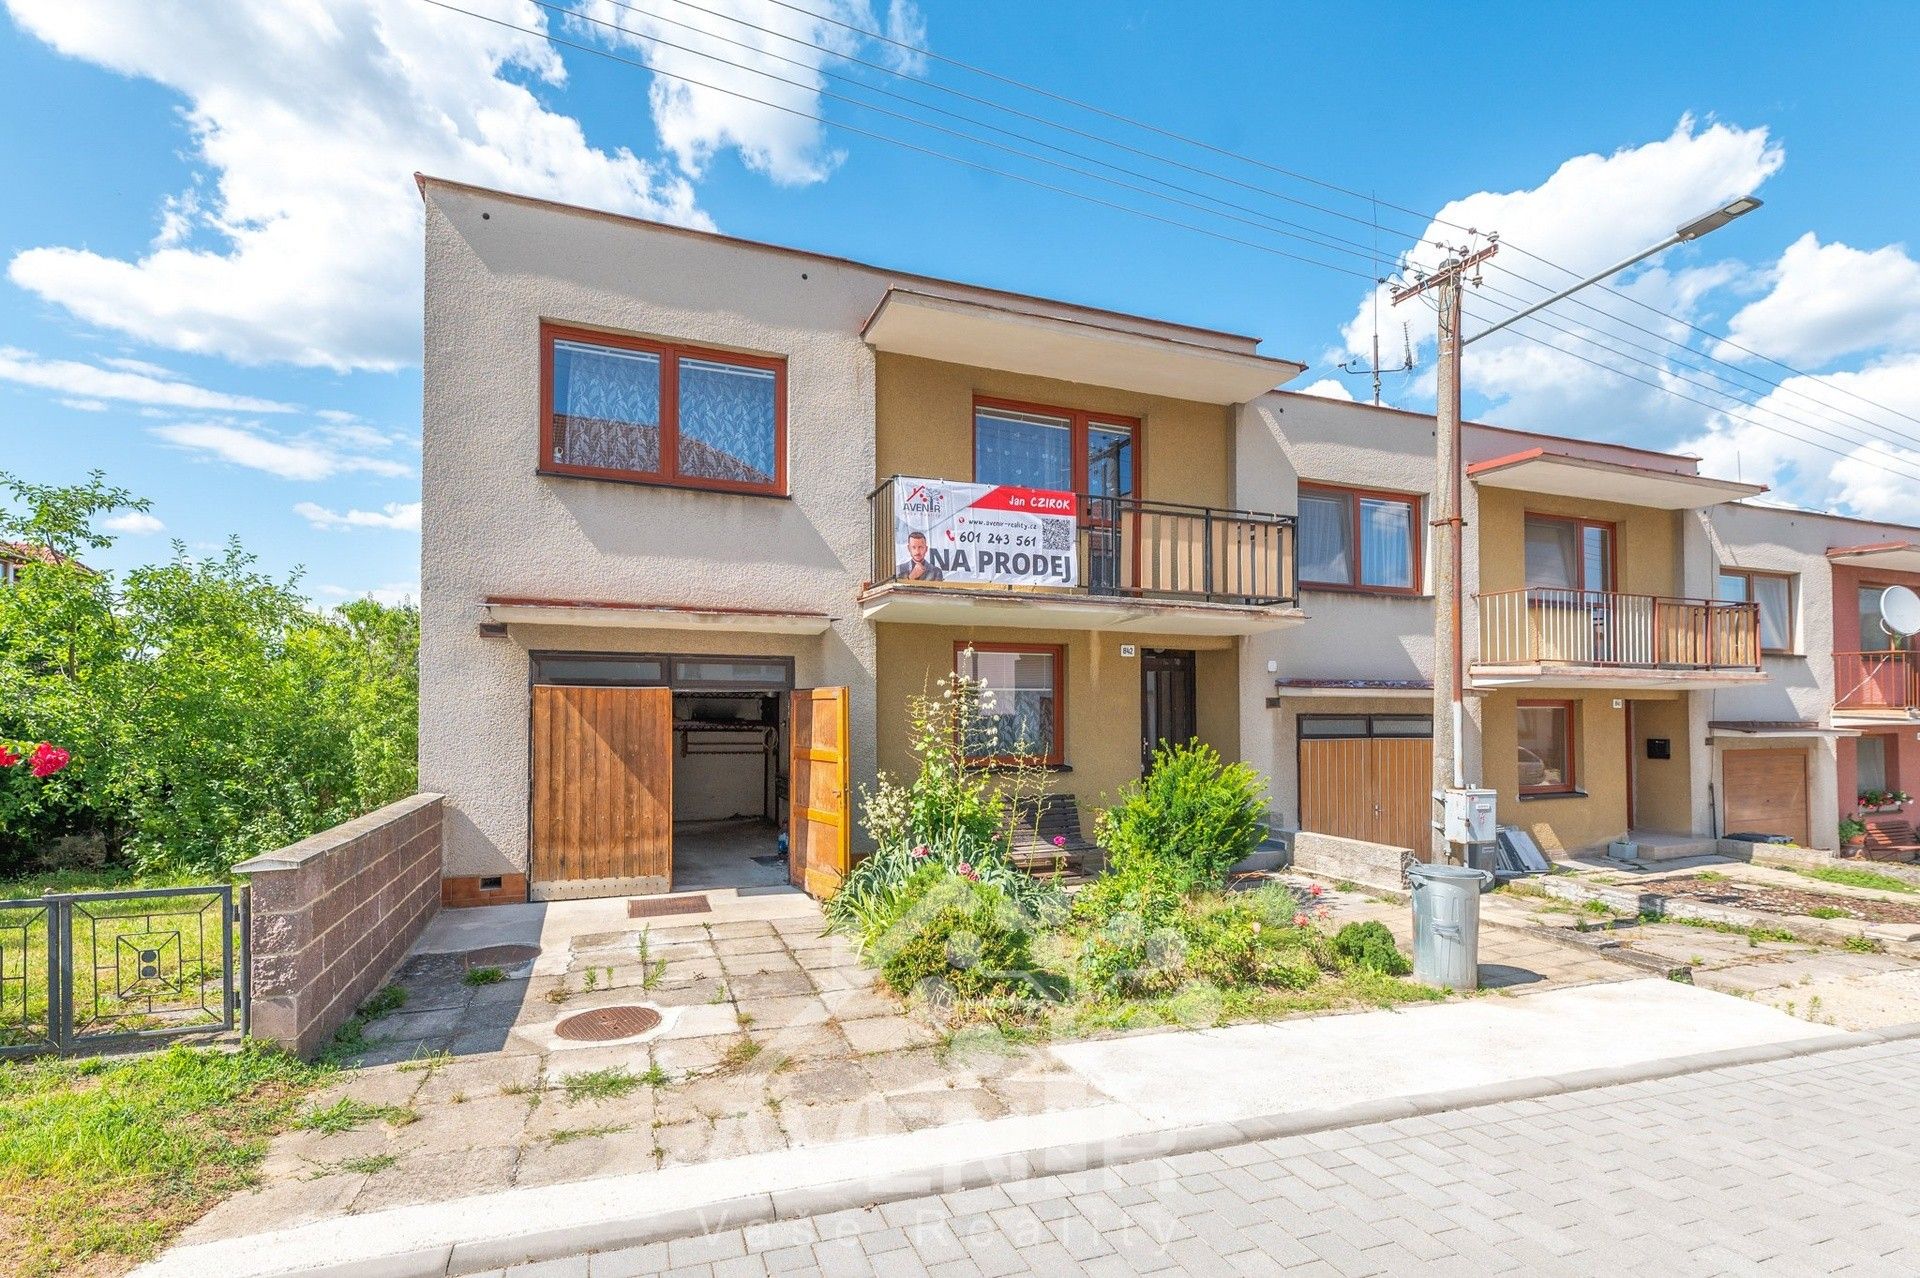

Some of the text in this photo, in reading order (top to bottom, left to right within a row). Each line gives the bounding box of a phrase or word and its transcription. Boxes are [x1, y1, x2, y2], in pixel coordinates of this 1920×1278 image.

[903, 502, 941, 513] AVENIR
[1008, 496, 1071, 510] Jan CZIROK
[959, 531, 1037, 547] 601 243 561
[929, 548, 1072, 583] NA PRODEJ
